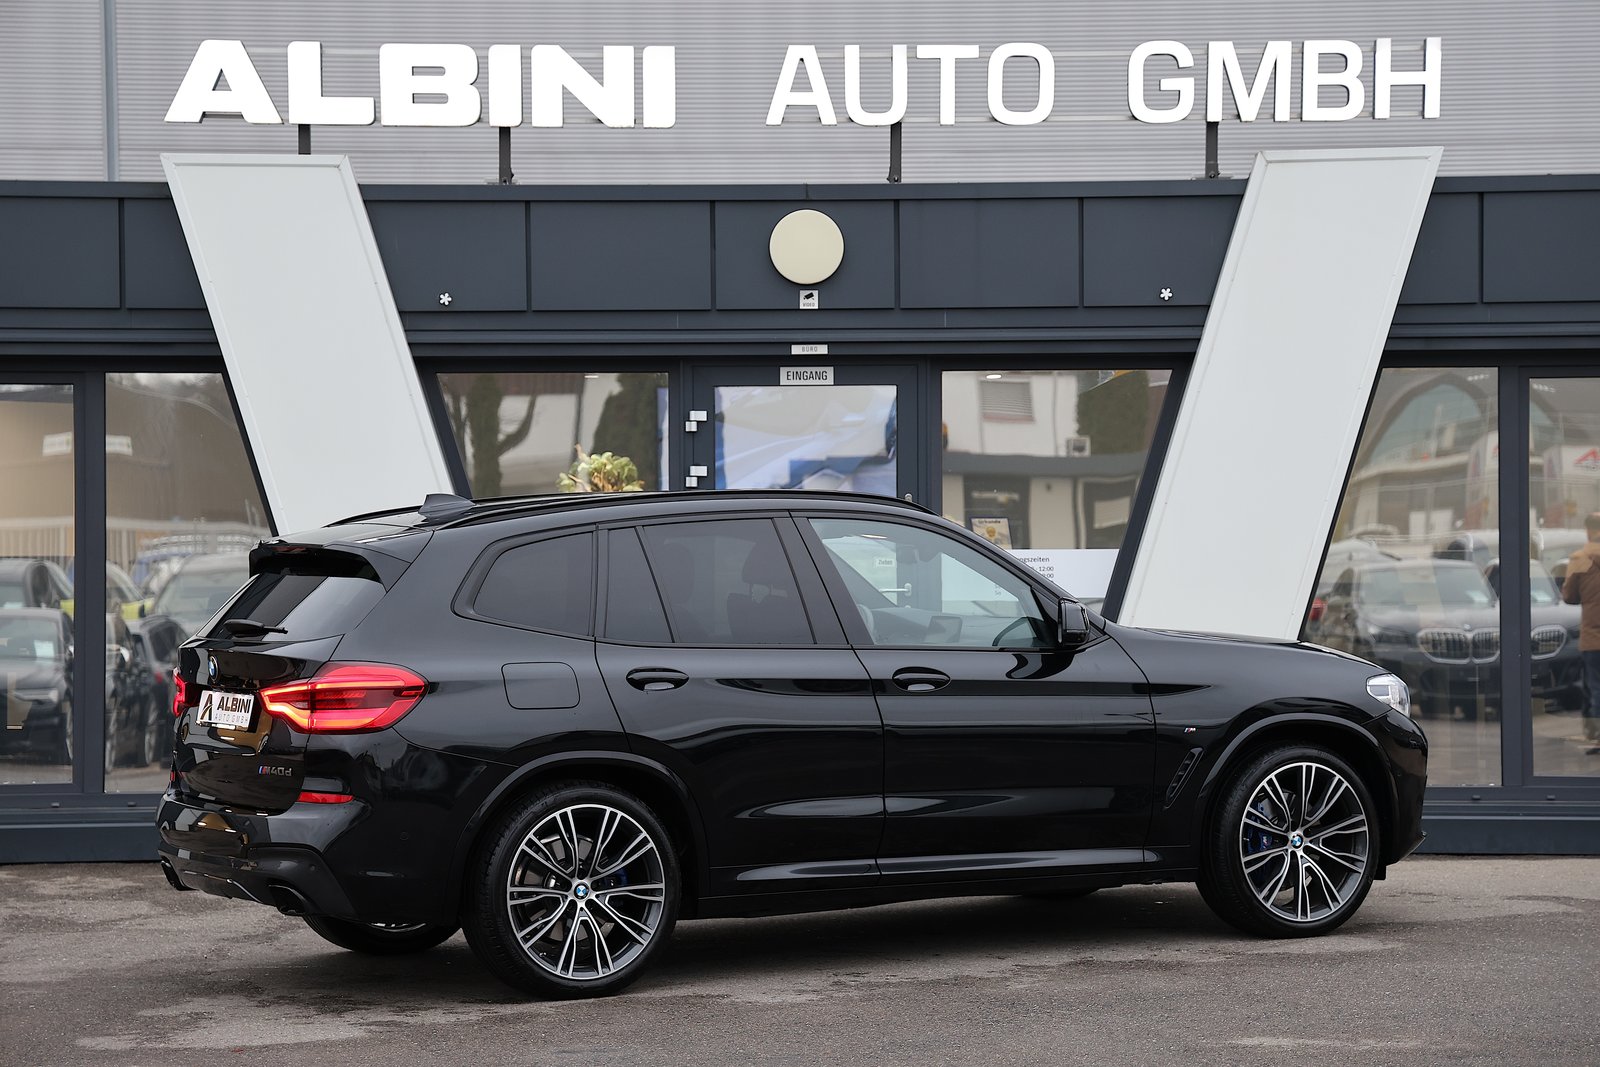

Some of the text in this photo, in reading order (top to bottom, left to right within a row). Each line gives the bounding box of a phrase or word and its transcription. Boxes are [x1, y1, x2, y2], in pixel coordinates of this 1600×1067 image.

[164, 36, 1443, 129] ALBINI AUTO GMBH
[786, 370, 828, 381] EINGANG
[217, 696, 251, 713] ALBINI
